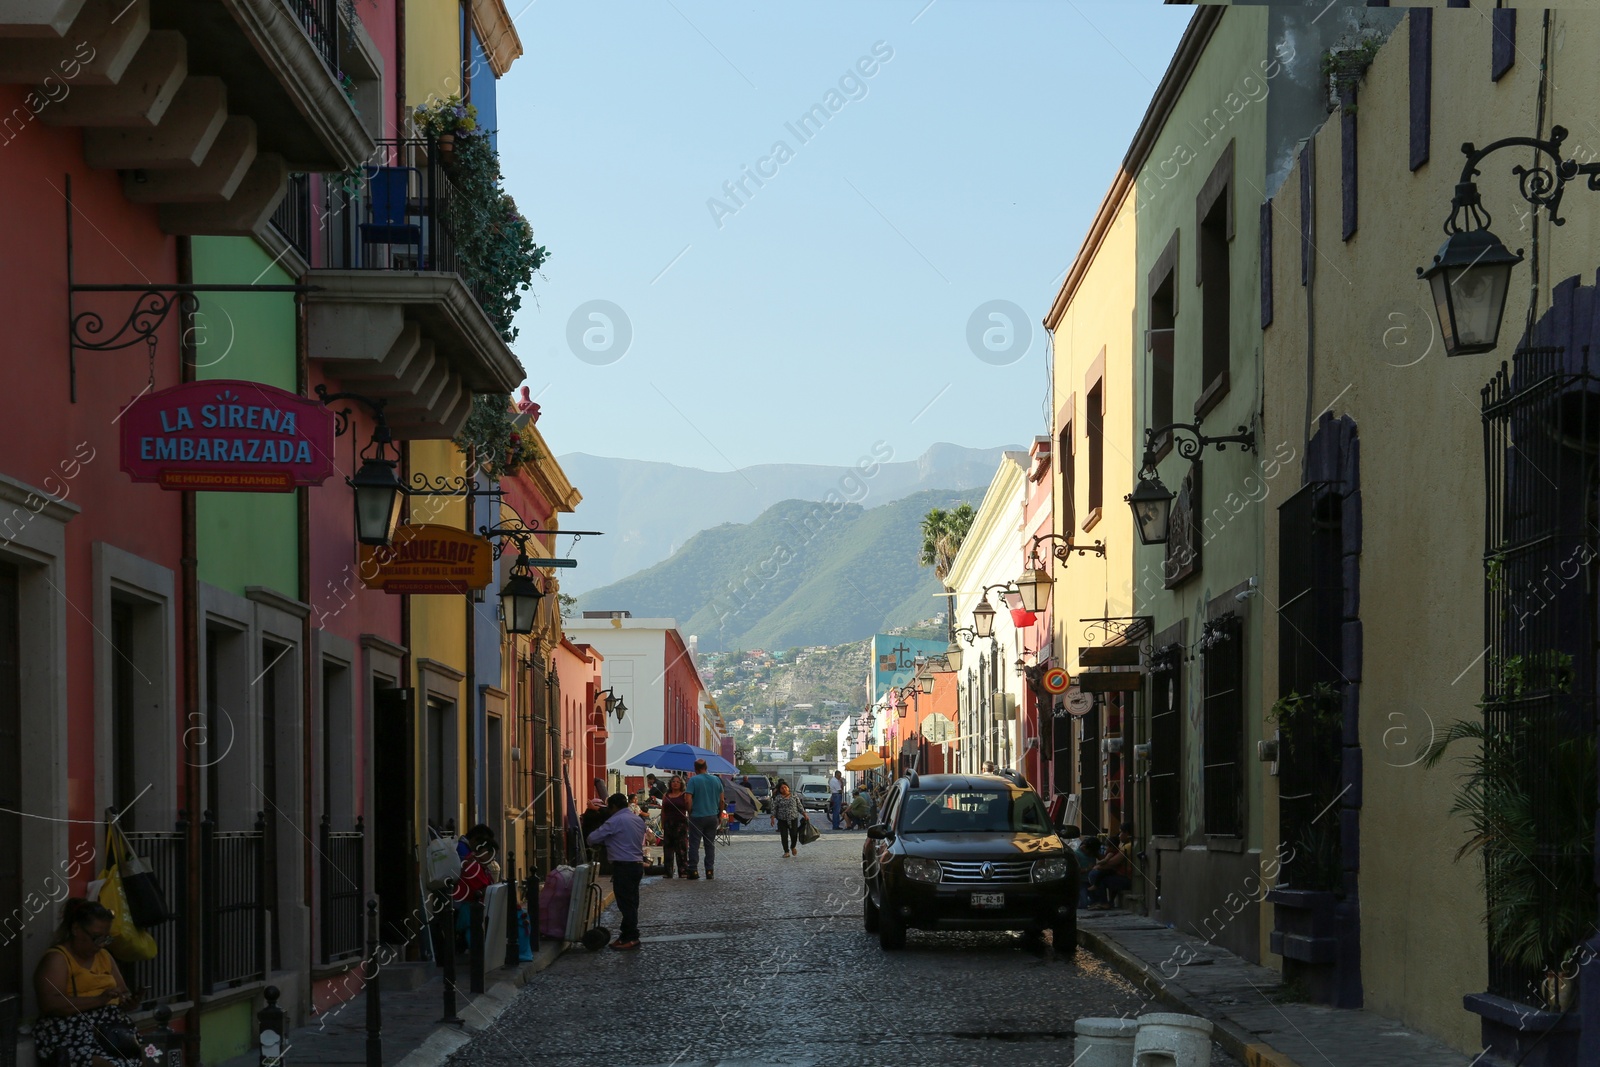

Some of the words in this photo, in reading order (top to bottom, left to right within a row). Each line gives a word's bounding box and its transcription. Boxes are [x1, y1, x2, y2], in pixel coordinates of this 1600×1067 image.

[159, 406, 195, 433] LA
[201, 403, 297, 436] SIRENA
[140, 436, 313, 464] EMBARAZADA
[165, 474, 182, 483] ME
[183, 475, 222, 484] MUERO
[223, 476, 239, 485] DE
[240, 476, 287, 485] HAMBRE
